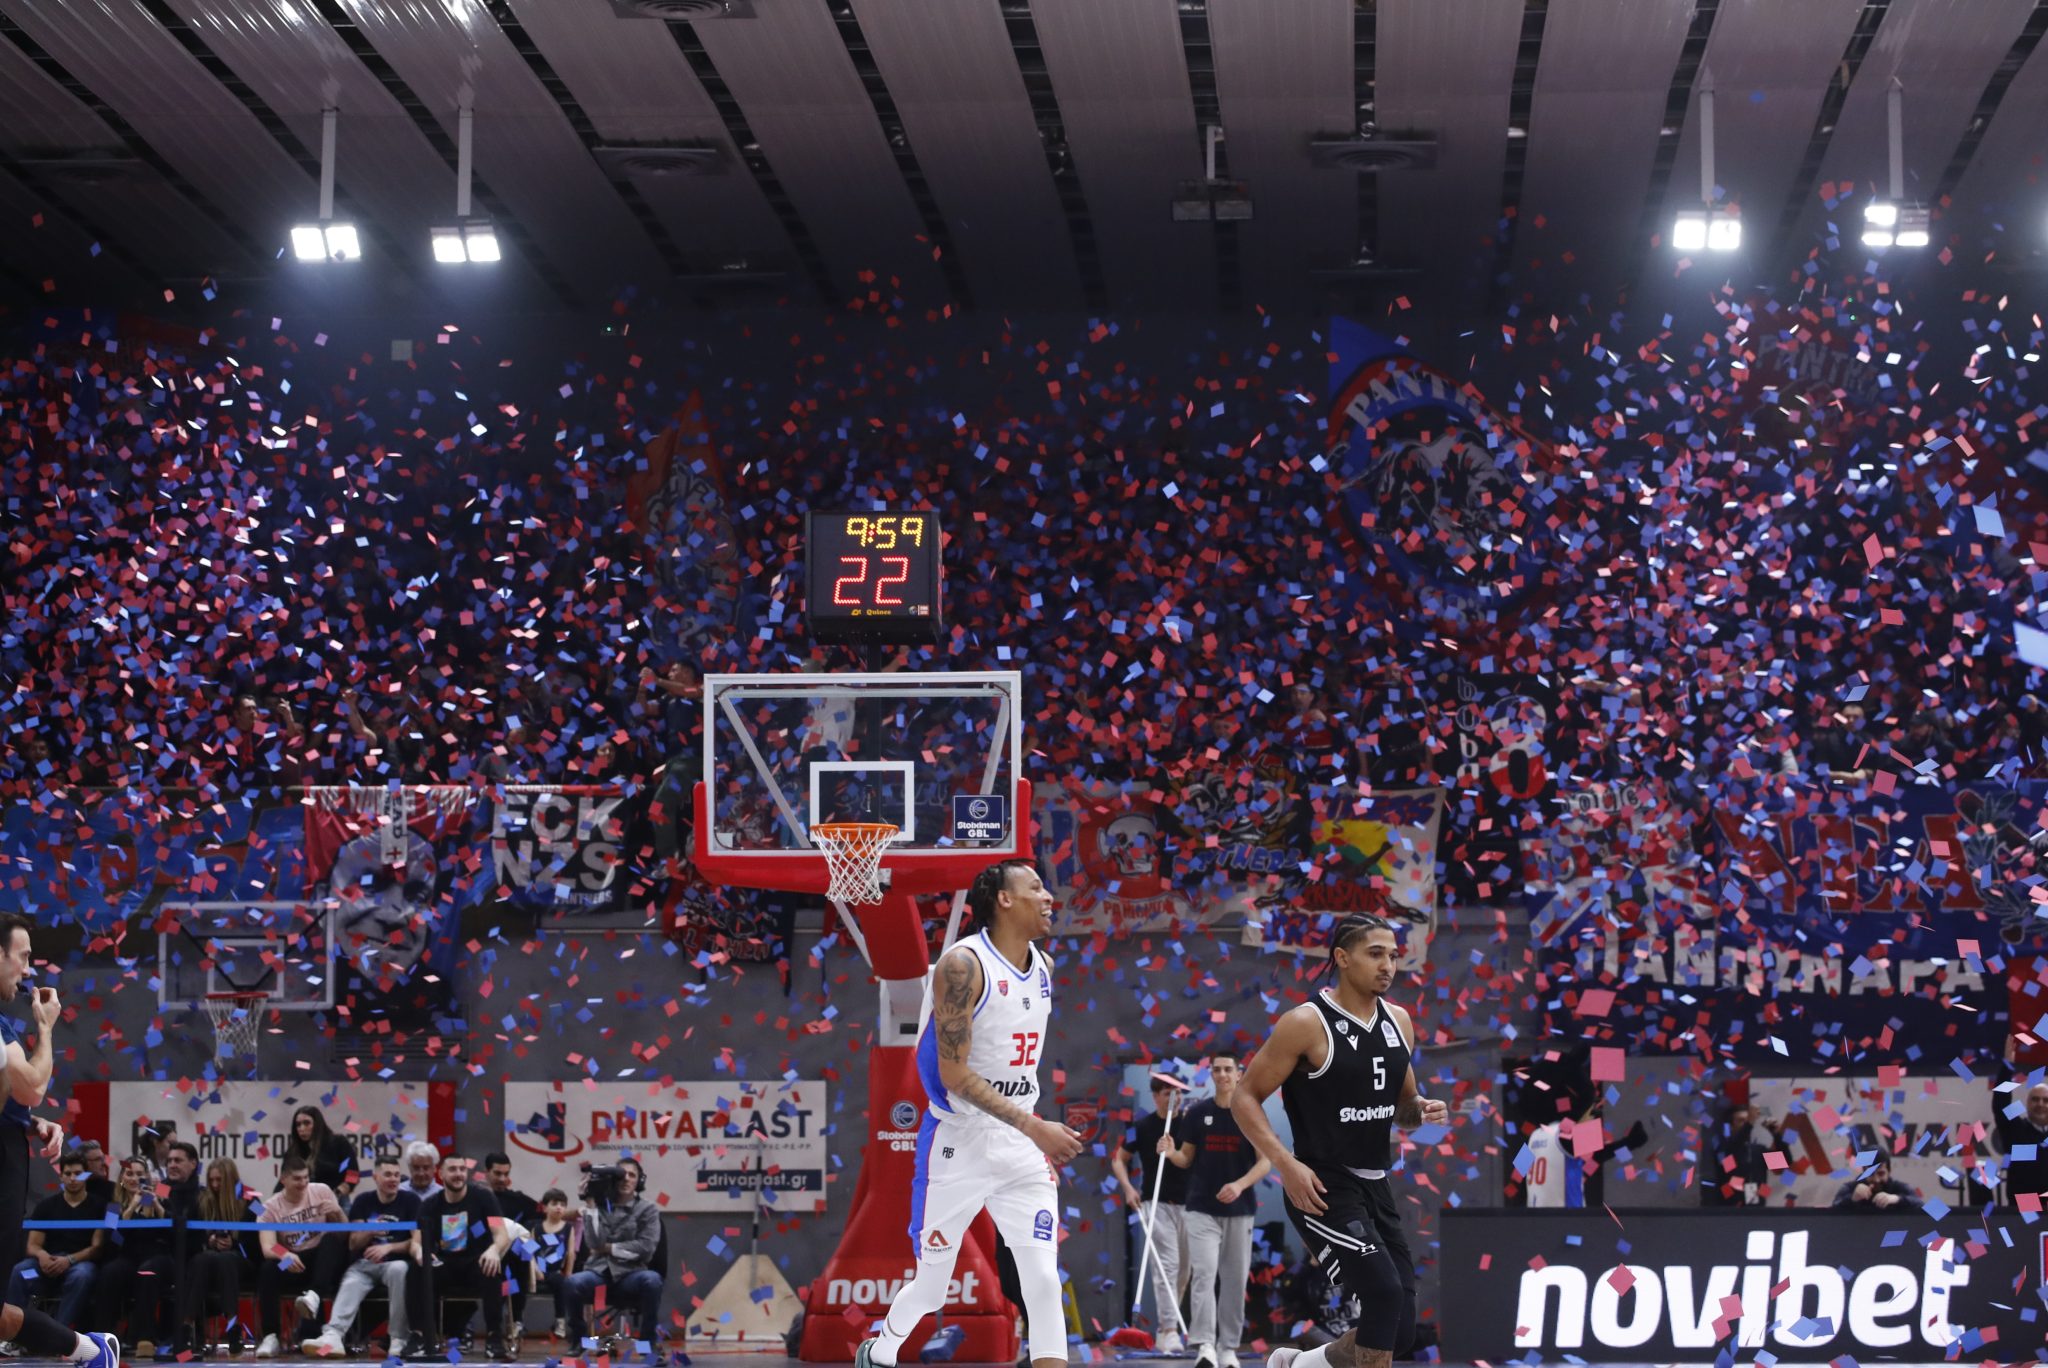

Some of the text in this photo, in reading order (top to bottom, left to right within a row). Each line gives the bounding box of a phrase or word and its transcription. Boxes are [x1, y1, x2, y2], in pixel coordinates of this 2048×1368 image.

[846, 517, 924, 549] 9:59
[834, 556, 909, 605] 22
[492, 793, 625, 842] FCK
[968, 830, 989, 838] GBL
[491, 840, 619, 892] NZS
[1009, 1031, 1039, 1067] 32
[1372, 1056, 1386, 1091] 5
[890, 1141, 917, 1151] GBL
[707, 1173, 808, 1189] drivaplast.gr
[826, 1268, 980, 1305] noviet
[1514, 1229, 1971, 1349] novibet
